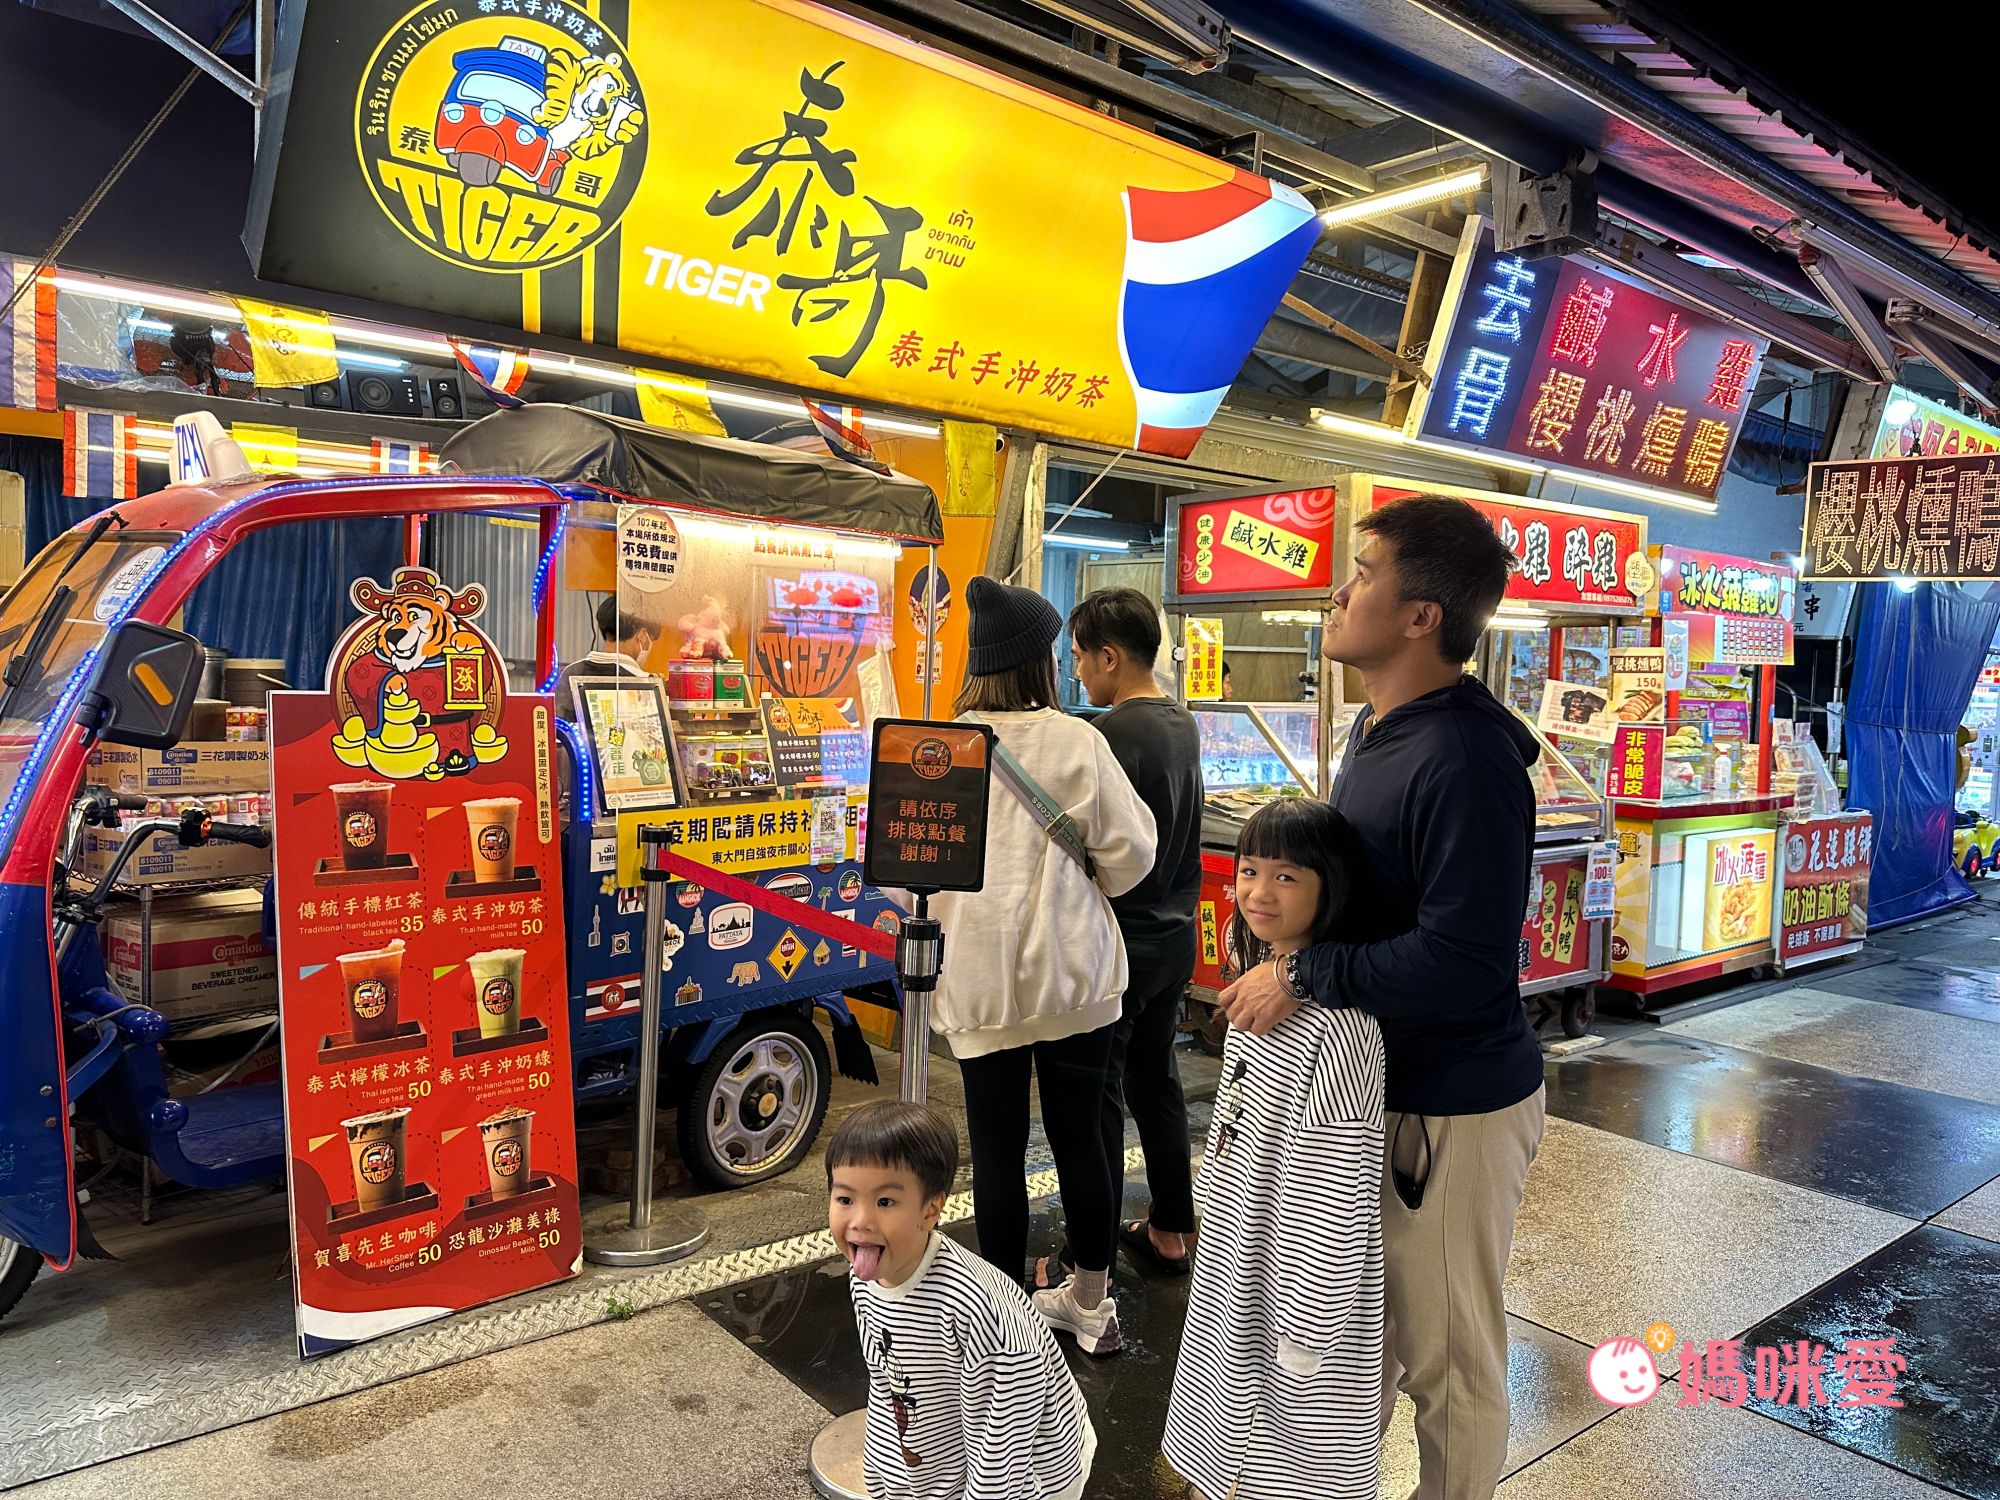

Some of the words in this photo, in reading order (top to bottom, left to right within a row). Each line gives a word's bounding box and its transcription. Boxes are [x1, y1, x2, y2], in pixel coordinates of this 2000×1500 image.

[508, 41, 536, 57] TAXI
[572, 171, 603, 199] 哥
[377, 159, 601, 263] TIGER
[705, 60, 928, 378] 泰哥
[643, 246, 772, 312] TIGER
[1449, 256, 1537, 437] 去骨
[888, 329, 1110, 410] 泰式手沖奶茶
[175, 422, 210, 480] TAXI
[1198, 518, 1211, 580] 健康少油
[1230, 520, 1309, 569] 鹹水雞
[757, 632, 855, 698] TIGER
[1637, 677, 1657, 688] 150
[1623, 731, 1647, 796] 非常脆皮
[899, 800, 958, 820] 請依序
[888, 820, 967, 844] 排隊點餐
[1594, 866, 1608, 880] 100
[297, 891, 423, 920] 傳統手標紅茶
[431, 897, 545, 925] 泰式手沖奶茶
[1782, 882, 1850, 926] 奶油酥條
[299, 923, 343, 935] Traditional
[346, 918, 398, 930] hand-labeled
[363, 928, 390, 937] black
[400, 915, 424, 933] 35
[460, 926, 476, 934] Thai
[477, 921, 518, 932] hand-made
[490, 931, 505, 939] milk
[521, 919, 543, 935] 50
[1542, 885, 1555, 953] 少油健康
[212, 942, 263, 962] Carnation
[191, 977, 236, 991] BEVERAGE
[237, 972, 275, 985] CREAMER
[210, 966, 259, 979] SWEETENED
[306, 1056, 431, 1094] 泰式檸檬冰茶
[438, 1049, 552, 1086] 泰式手沖奶綠
[361, 1090, 378, 1099] Thai
[379, 1085, 404, 1096] lemon
[378, 1096, 389, 1104] ice
[391, 1094, 404, 1102] tea
[407, 1079, 432, 1100] 50
[467, 1085, 483, 1093] Thai
[484, 1077, 525, 1090] hand-made
[475, 1091, 496, 1101] green
[497, 1087, 512, 1096] milk
[513, 1085, 525, 1093] tea
[528, 1071, 551, 1090] 50
[313, 1220, 438, 1270] 賀喜先生咖啡
[478, 1243, 511, 1258] Dinosaur
[512, 1237, 535, 1248] Beach
[520, 1245, 536, 1255] Milo
[538, 1229, 561, 1249] 50
[388, 1260, 415, 1273] Coffee
[418, 1243, 442, 1265] 50
